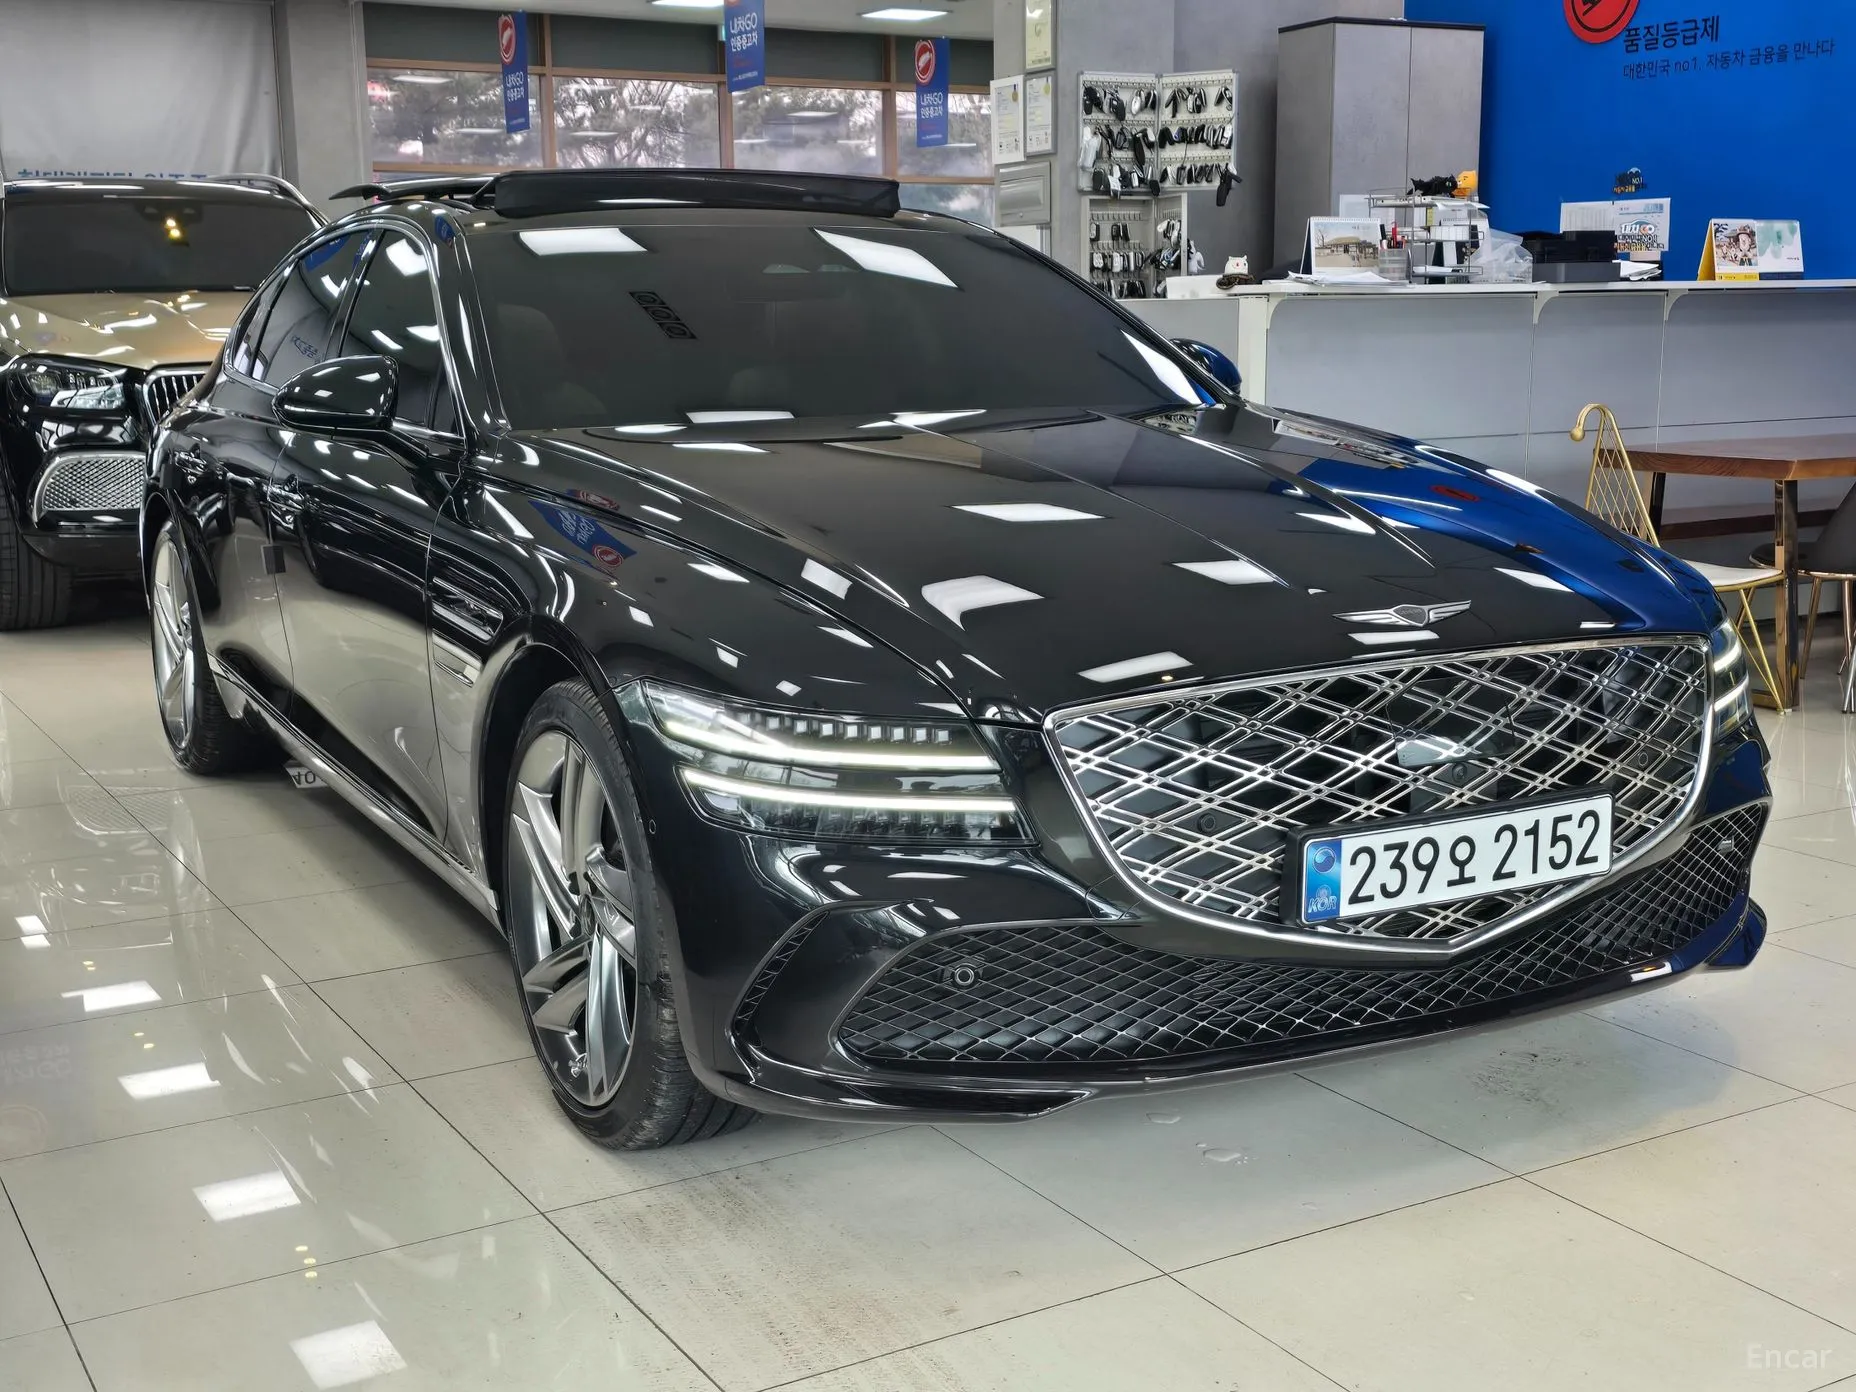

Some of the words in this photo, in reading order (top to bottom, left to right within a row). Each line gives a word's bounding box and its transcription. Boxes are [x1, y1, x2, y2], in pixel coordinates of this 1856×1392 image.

[1623, 15, 1720, 54] 품질등급제
[1623, 59, 1671, 80] 대한민국
[1706, 51, 1745, 70] 자동차
[1750, 44, 1789, 66] 금융을
[1793, 37, 1835, 61] 만나다
[1348, 835, 1476, 905] 239오
[1492, 809, 1600, 882] 2152
[1308, 895, 1337, 913] KOR
